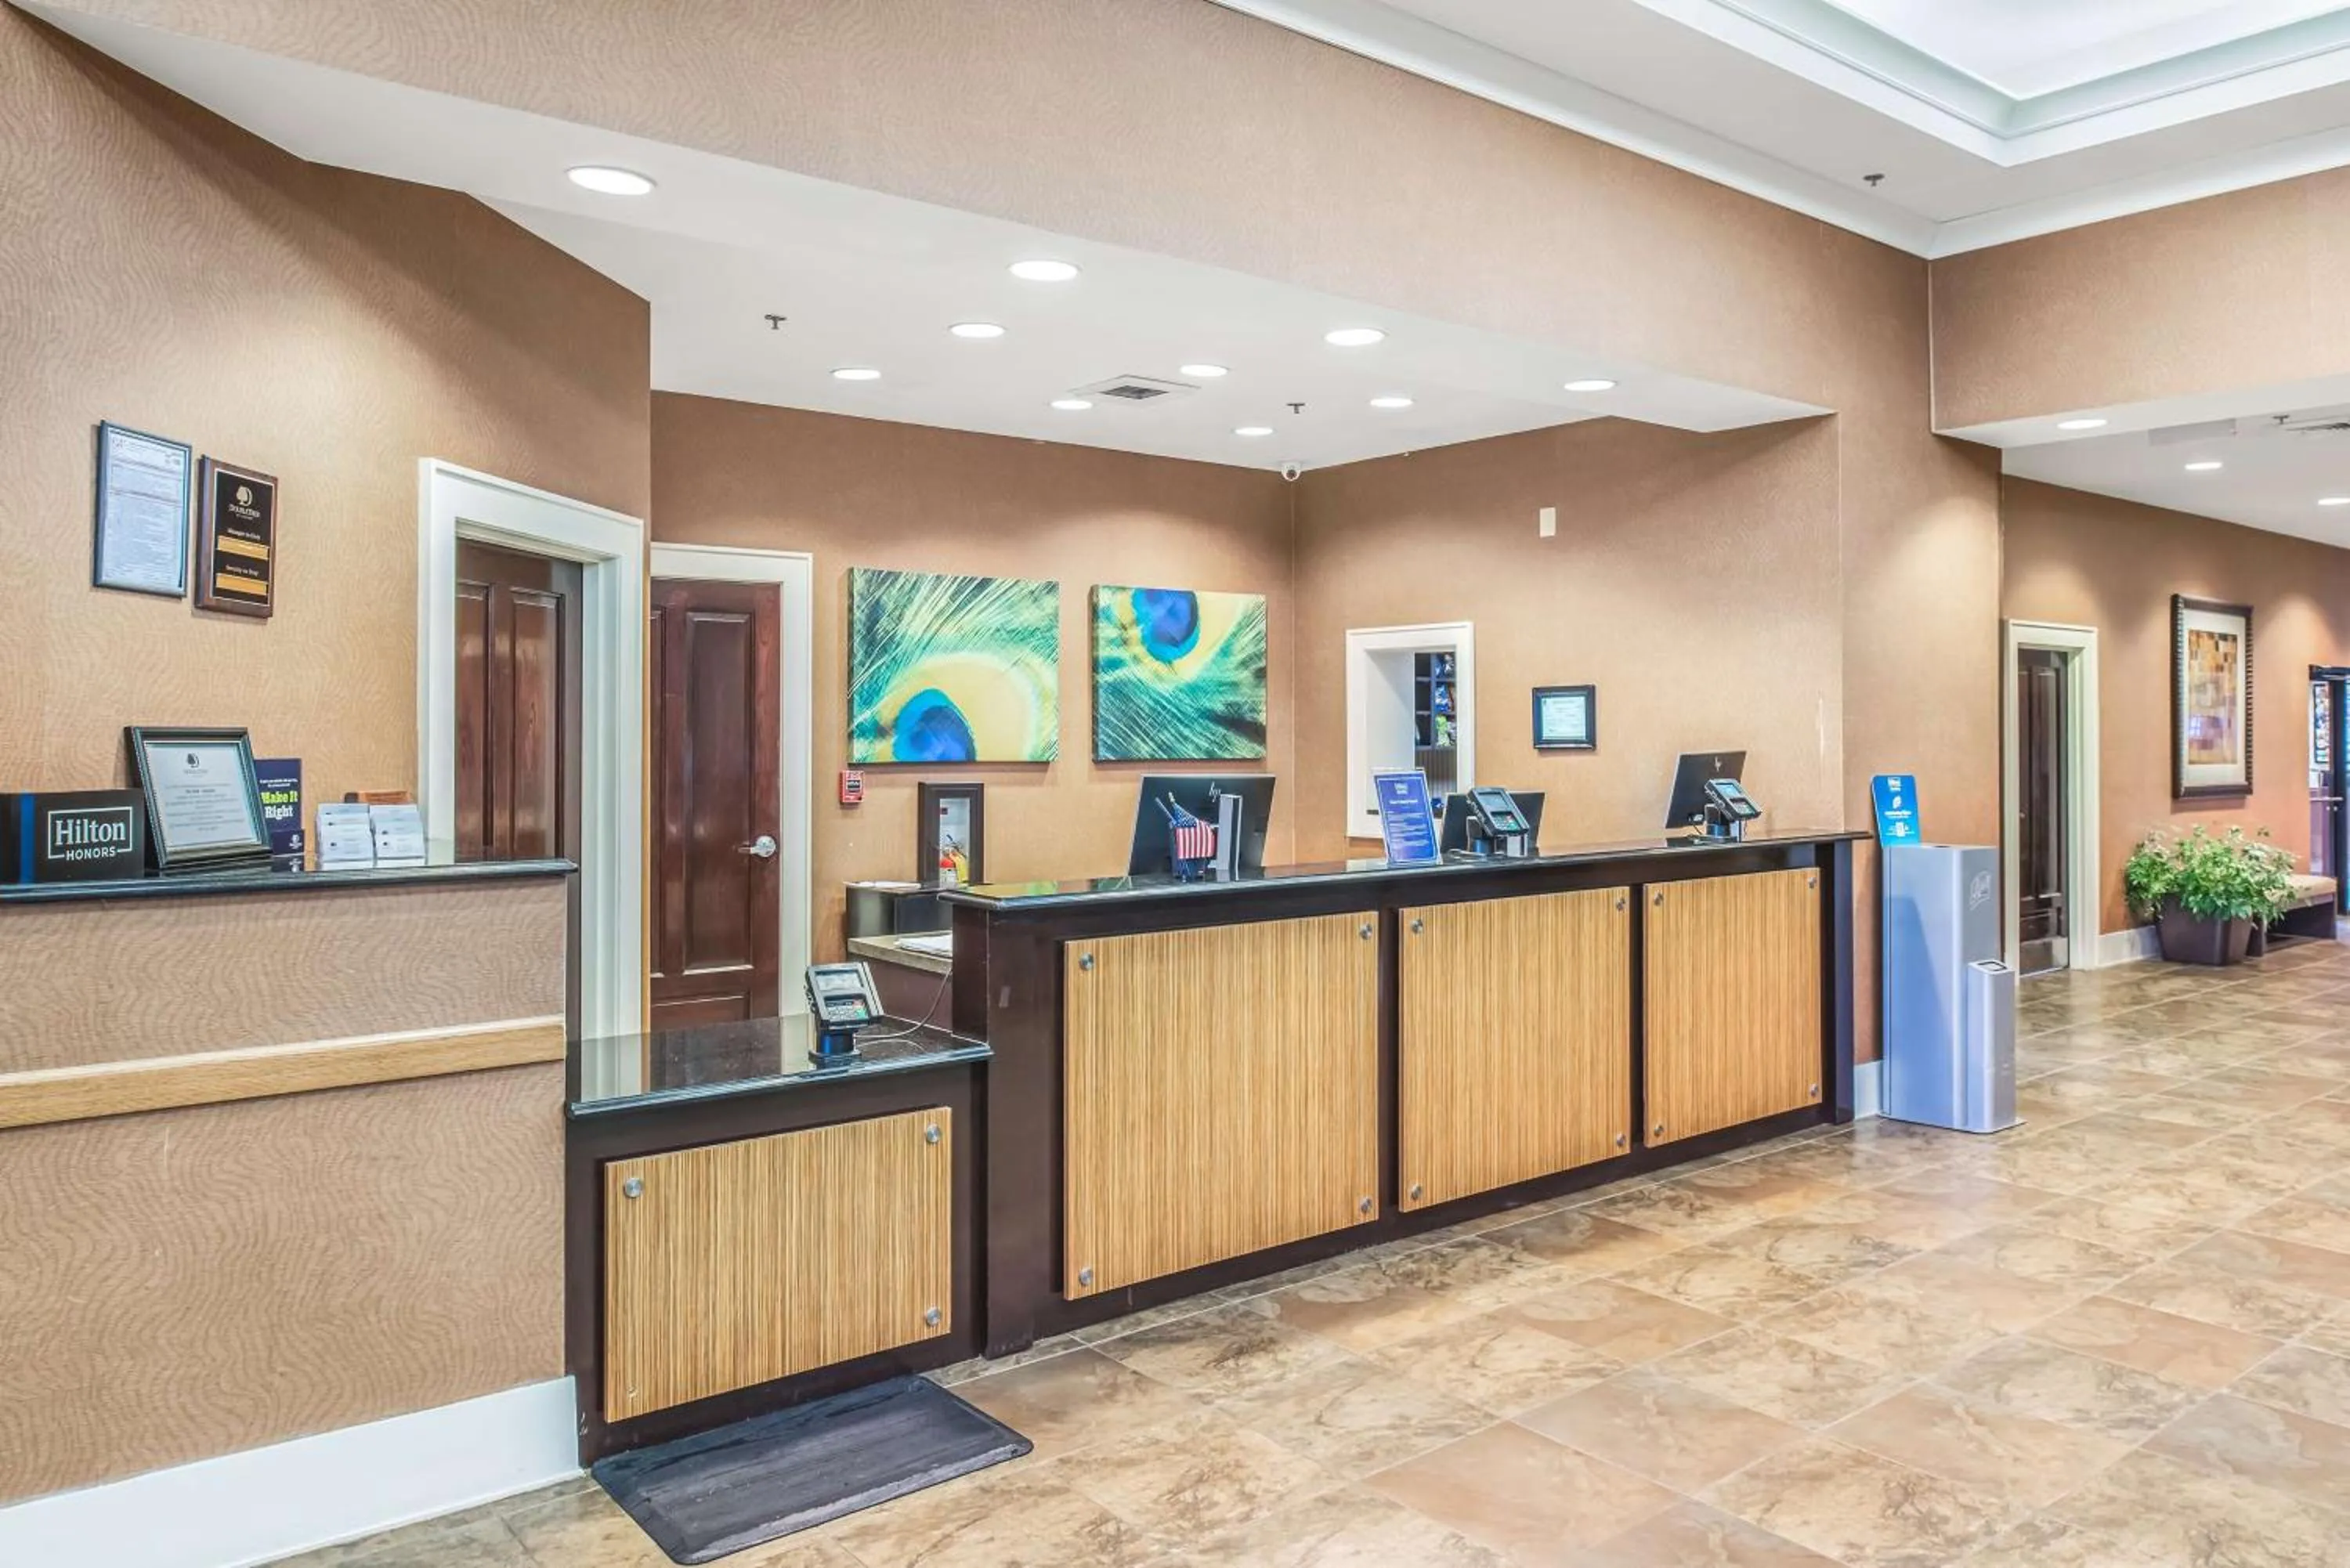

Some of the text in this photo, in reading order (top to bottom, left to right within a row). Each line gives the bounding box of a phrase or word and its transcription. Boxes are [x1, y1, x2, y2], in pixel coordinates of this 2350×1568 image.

[261, 791, 288, 804] Make
[264, 805, 293, 820] Right
[55, 818, 126, 846] Hilton
[66, 847, 116, 861] HONORS
